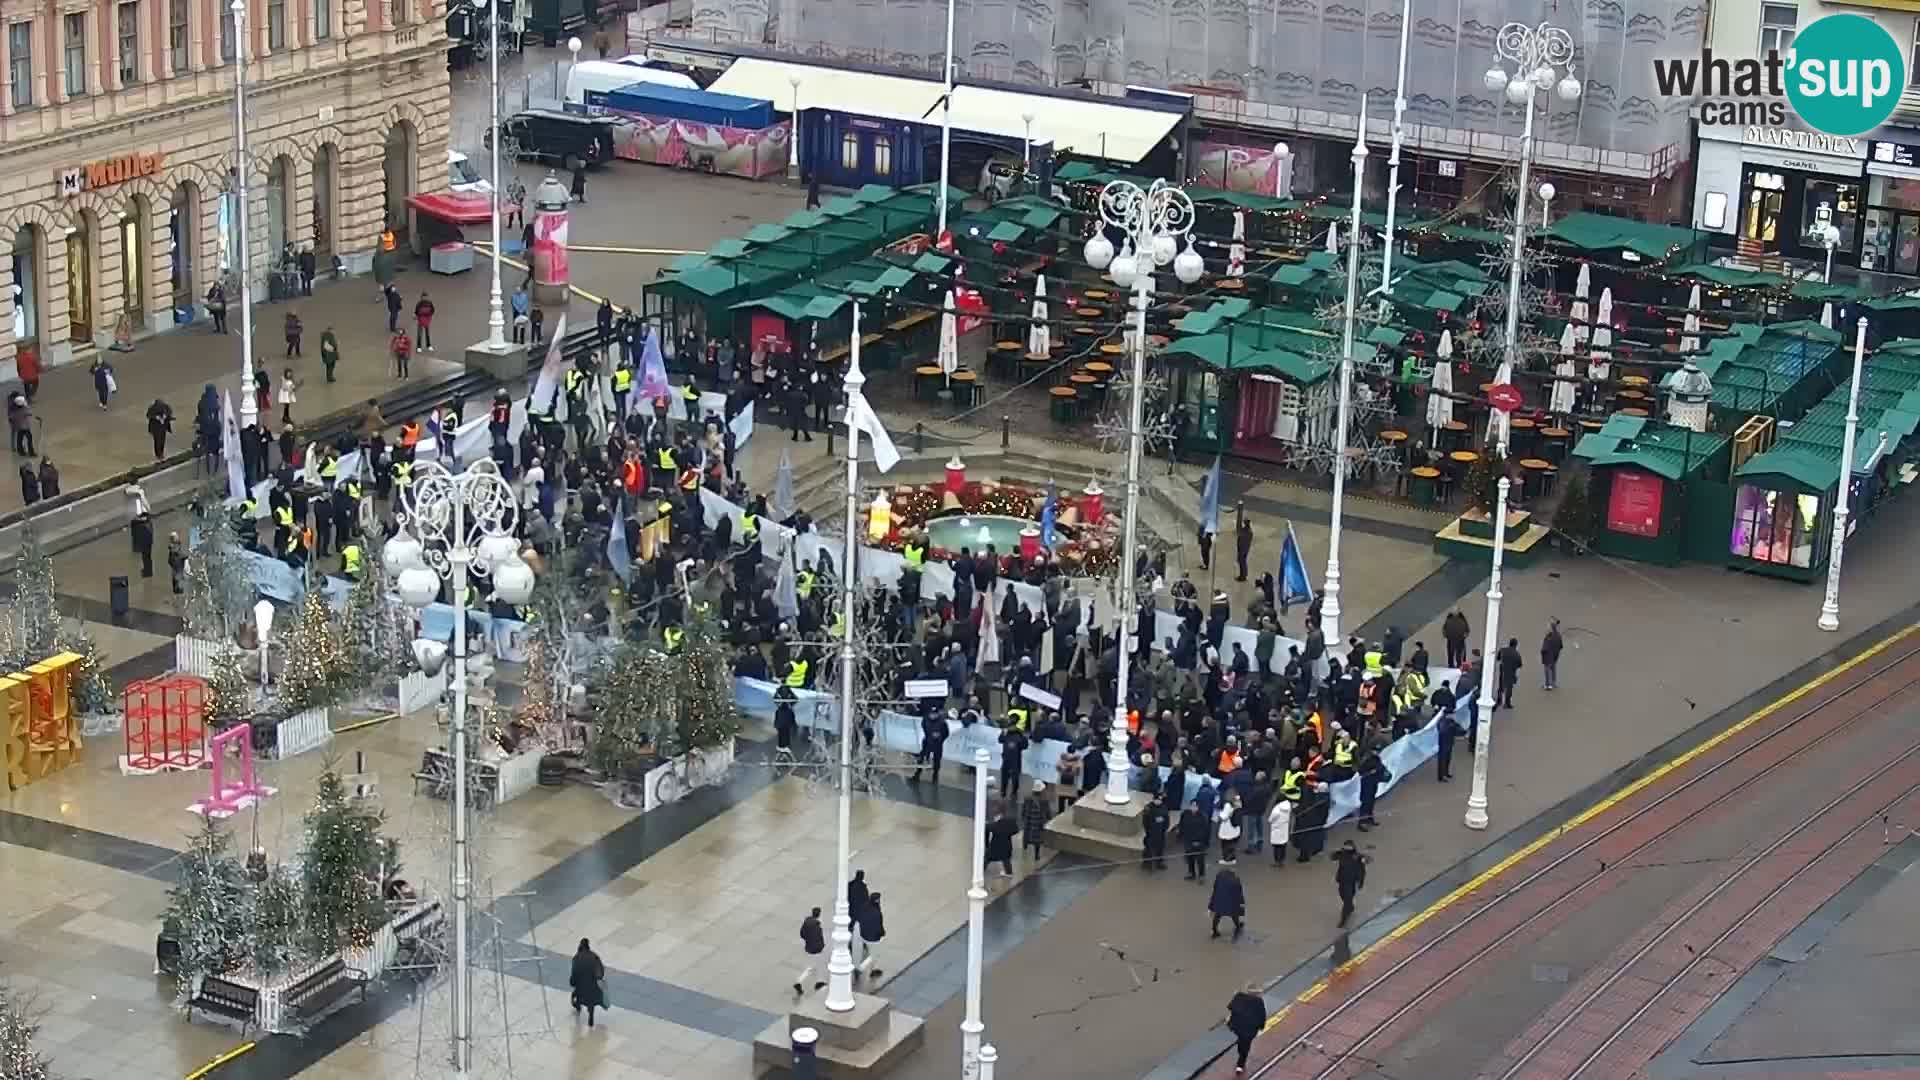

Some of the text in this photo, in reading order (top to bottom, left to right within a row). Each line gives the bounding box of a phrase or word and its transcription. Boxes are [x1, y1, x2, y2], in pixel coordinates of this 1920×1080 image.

[1748, 127, 1859, 154] MARTIMEX
[65, 152, 164, 190] M Müller
[1782, 159, 1820, 172] CHANEL
